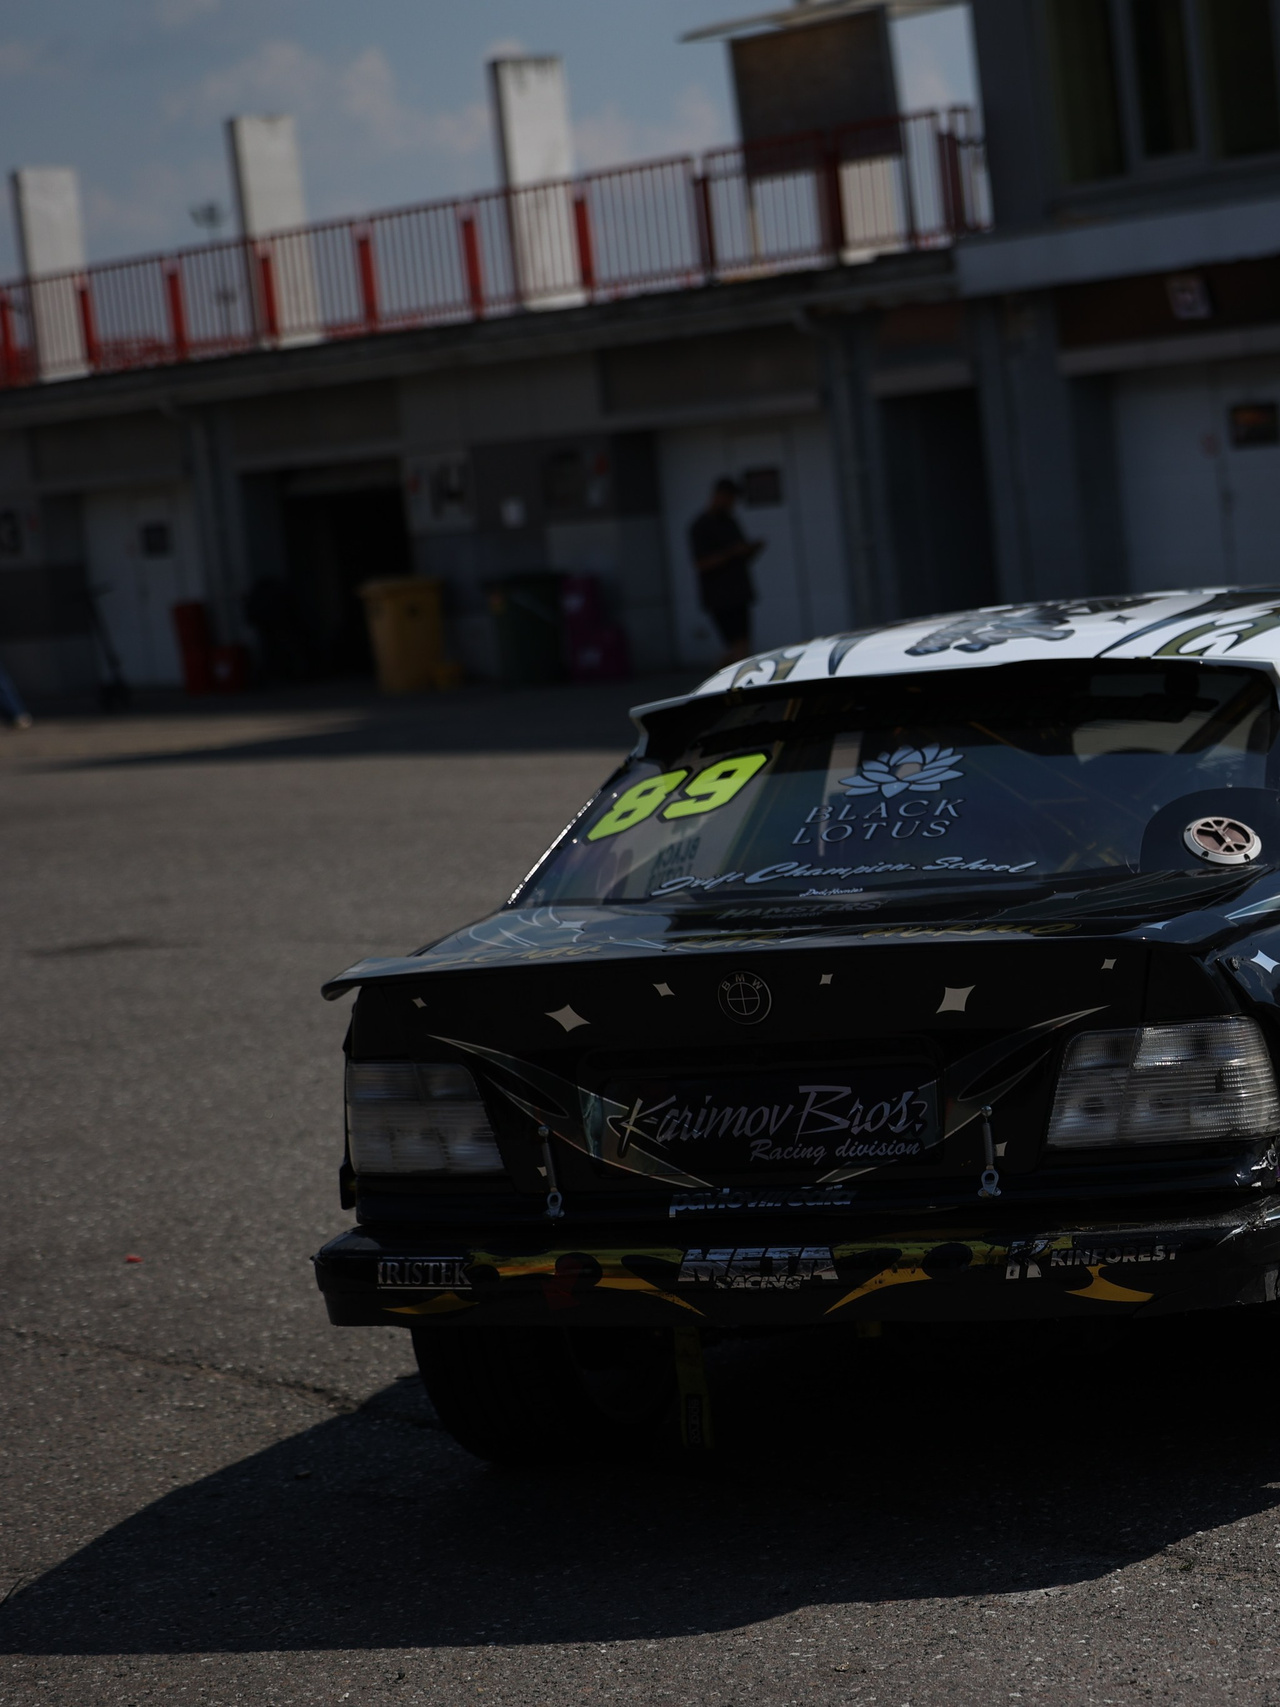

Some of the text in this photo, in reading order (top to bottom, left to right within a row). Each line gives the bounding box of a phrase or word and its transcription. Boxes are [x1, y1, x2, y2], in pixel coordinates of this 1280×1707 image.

[583, 750, 771, 844] 89
[803, 798, 966, 826] BLACK
[791, 819, 951, 845] LOTUS
[744, 860, 917, 884] Champion
[921, 855, 1038, 875] School
[717, 900, 885, 920] HAMSTERS
[721, 973, 763, 991] BMW
[617, 1094, 794, 1152] Karimov
[750, 1136, 920, 1166] Racing division
[677, 1246, 840, 1283] META
[1050, 1242, 1182, 1268] KINFOREST
[376, 1261, 472, 1286] IRISTEK
[714, 1274, 805, 1291] RACING
